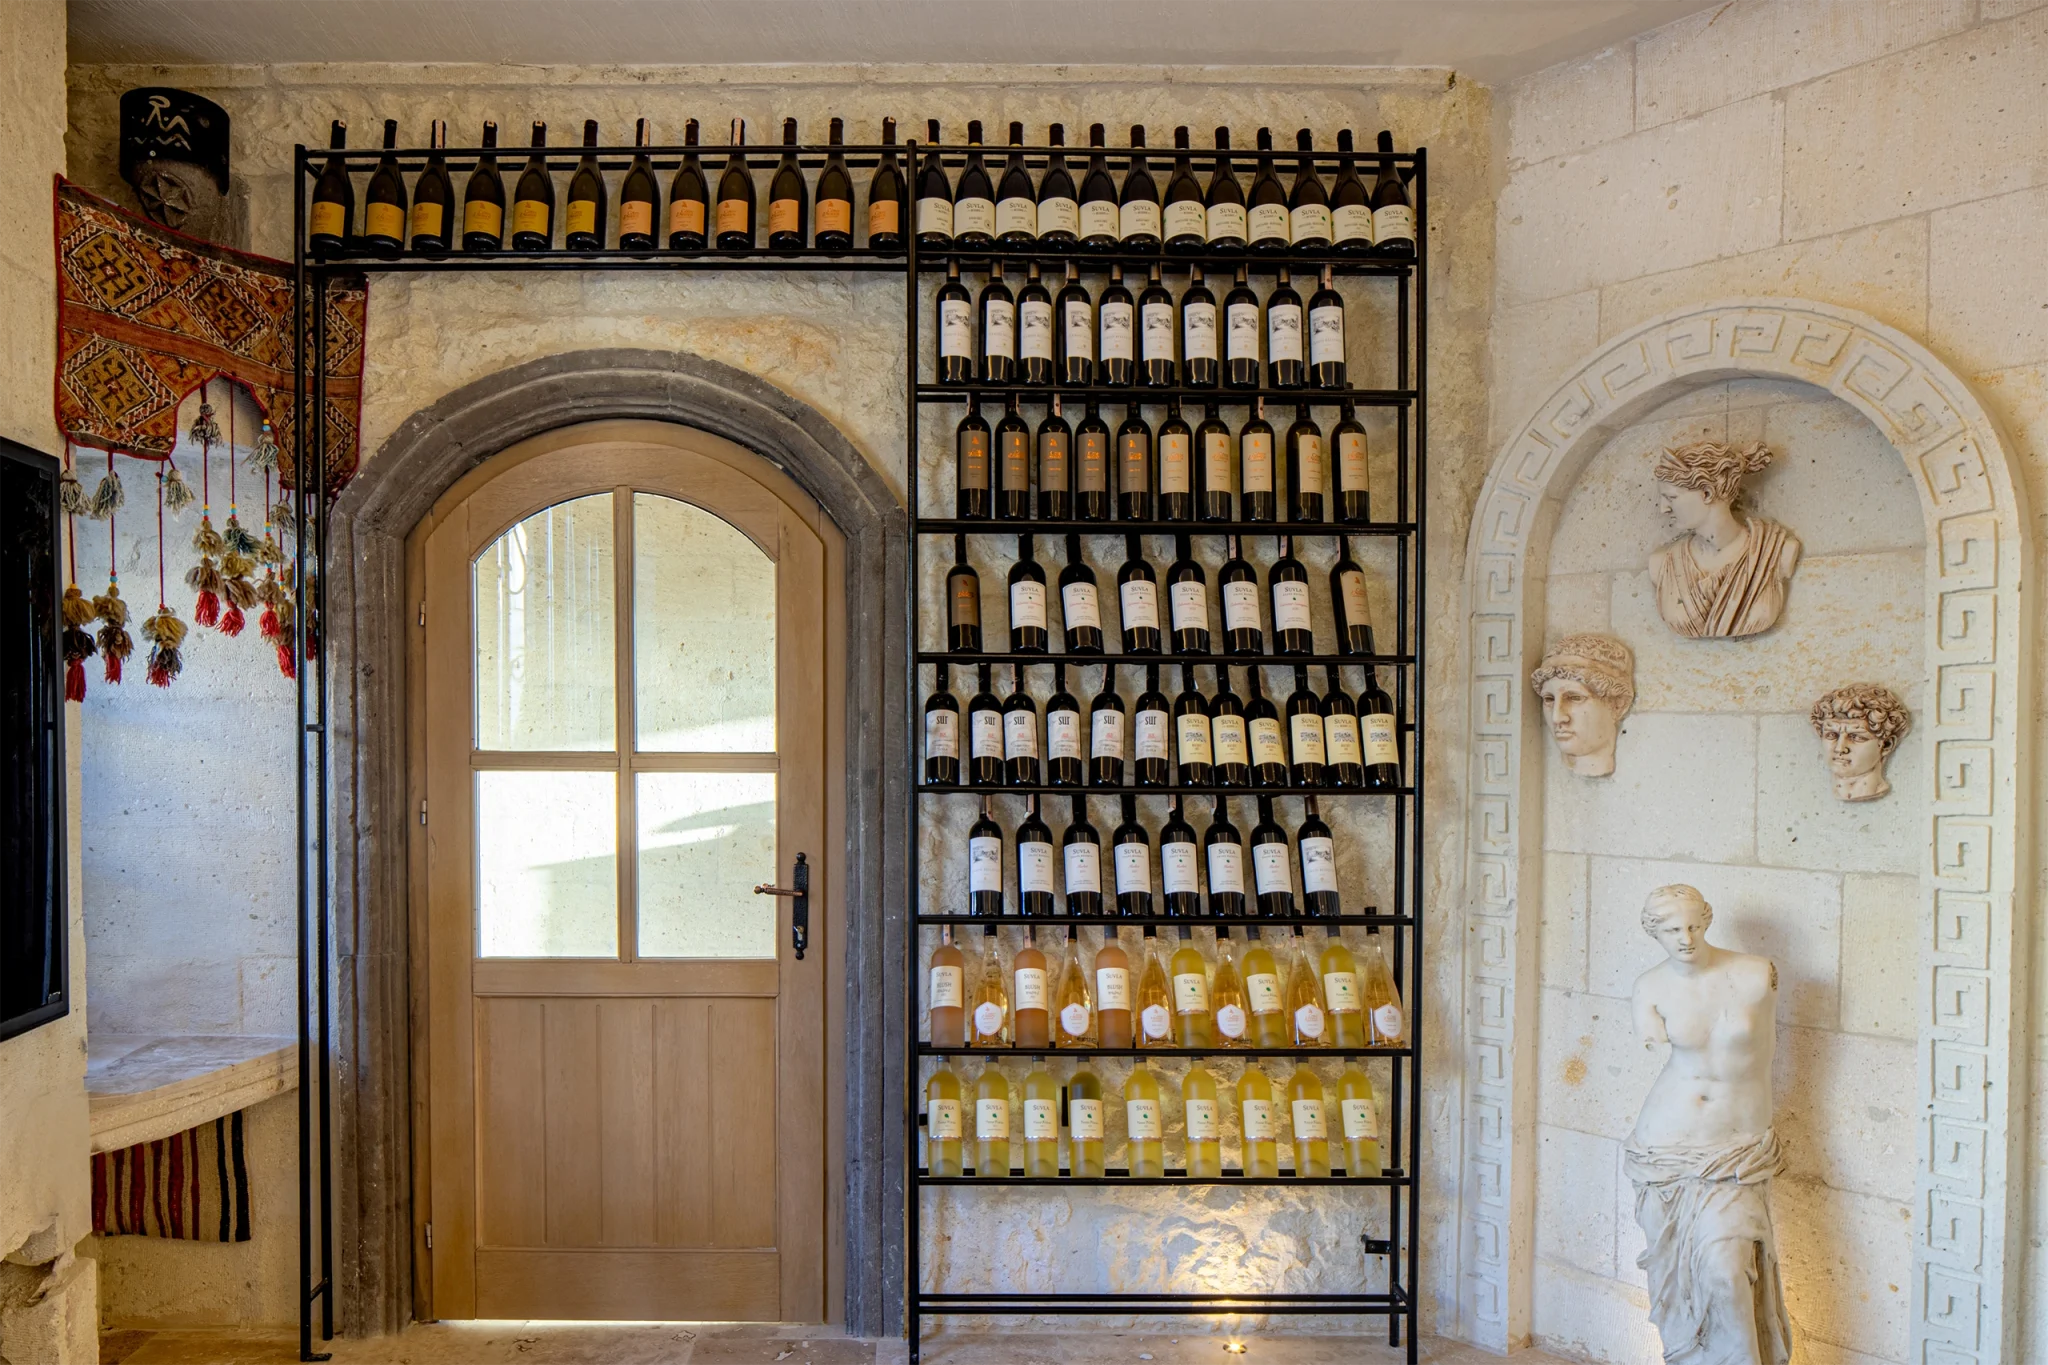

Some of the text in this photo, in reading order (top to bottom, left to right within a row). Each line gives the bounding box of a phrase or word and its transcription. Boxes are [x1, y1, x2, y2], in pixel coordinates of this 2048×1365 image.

[934, 203, 950, 212] SUVLA
[1056, 202, 1072, 210] SUVLA
[936, 715, 948, 725] sur
[984, 716, 996, 726] sur
[1014, 716, 1026, 725] sur
[1058, 716, 1071, 725] sur
[1104, 715, 1115, 725] sur
[1145, 716, 1157, 725] sur
